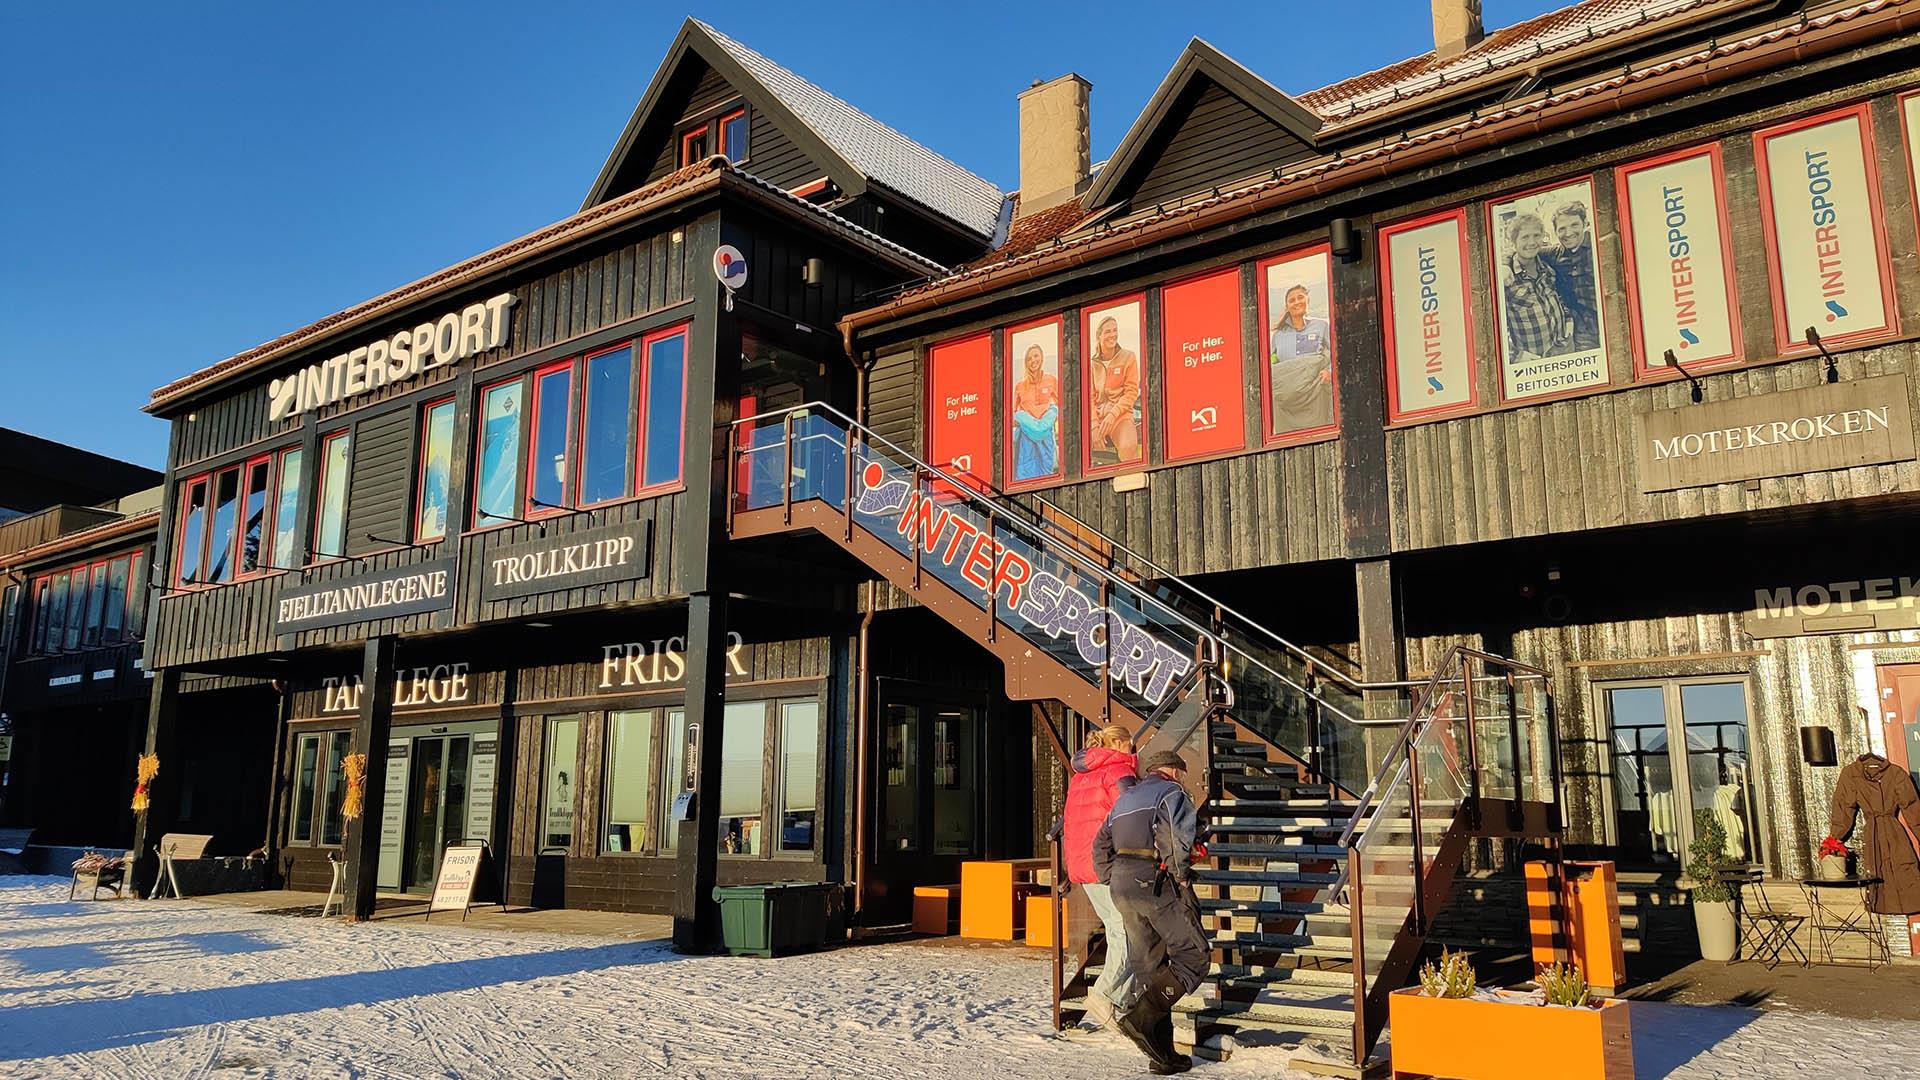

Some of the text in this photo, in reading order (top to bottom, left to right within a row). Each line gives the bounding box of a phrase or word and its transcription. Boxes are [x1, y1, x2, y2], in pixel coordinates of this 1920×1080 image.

[1805, 150, 1845, 298] INTERSPORT
[1663, 186, 1698, 326] INTERSPORT
[1418, 247, 1443, 374] INTERSPORT
[295, 293, 515, 414] INTERSPORT
[1182, 337, 1224, 352] For Her.
[1184, 351, 1223, 368] By Her.
[1525, 355, 1598, 377] INTERSPORT
[946, 393, 979, 407] For Her.
[1516, 370, 1599, 393] BEITOSTØLEN
[947, 407, 977, 421] By Her.
[1652, 404, 1890, 461] MOTEKROKEN
[492, 535, 634, 587] TROLLKLIPP
[277, 570, 448, 624] FJELLTANNLEGENE
[897, 489, 1192, 706] INTERSPORT
[599, 631, 748, 688] FRISR
[446, 856, 476, 865] FRISØR
